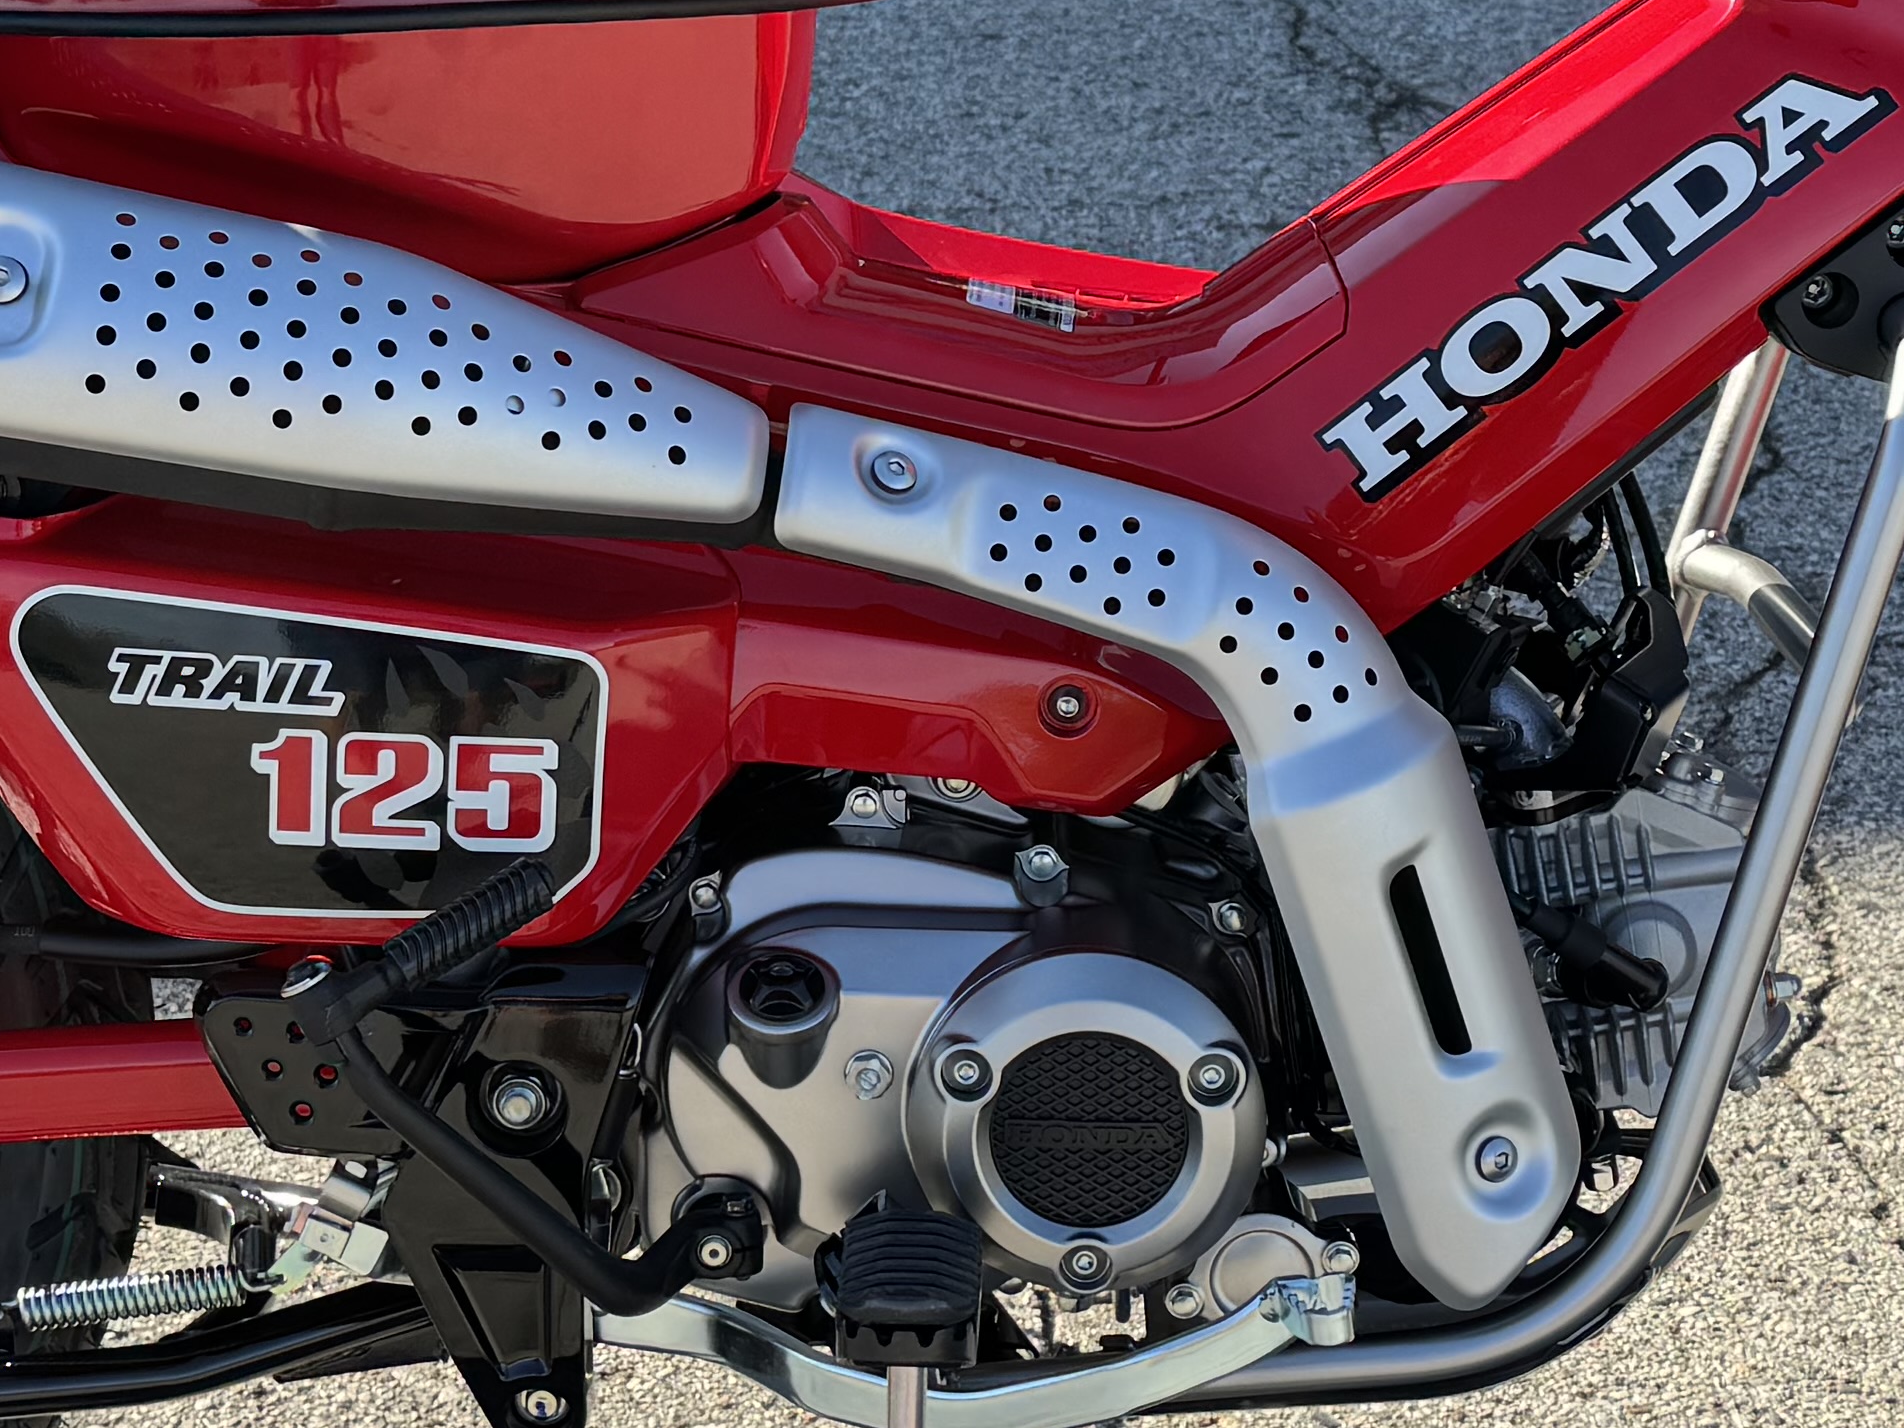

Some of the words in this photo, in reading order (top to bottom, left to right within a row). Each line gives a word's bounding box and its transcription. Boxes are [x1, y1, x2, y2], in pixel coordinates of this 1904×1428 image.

[1317, 75, 1890, 498] HONDA
[107, 647, 346, 717] TRAIL
[250, 728, 559, 853] 125
[1007, 1122, 1170, 1147] HONDA
